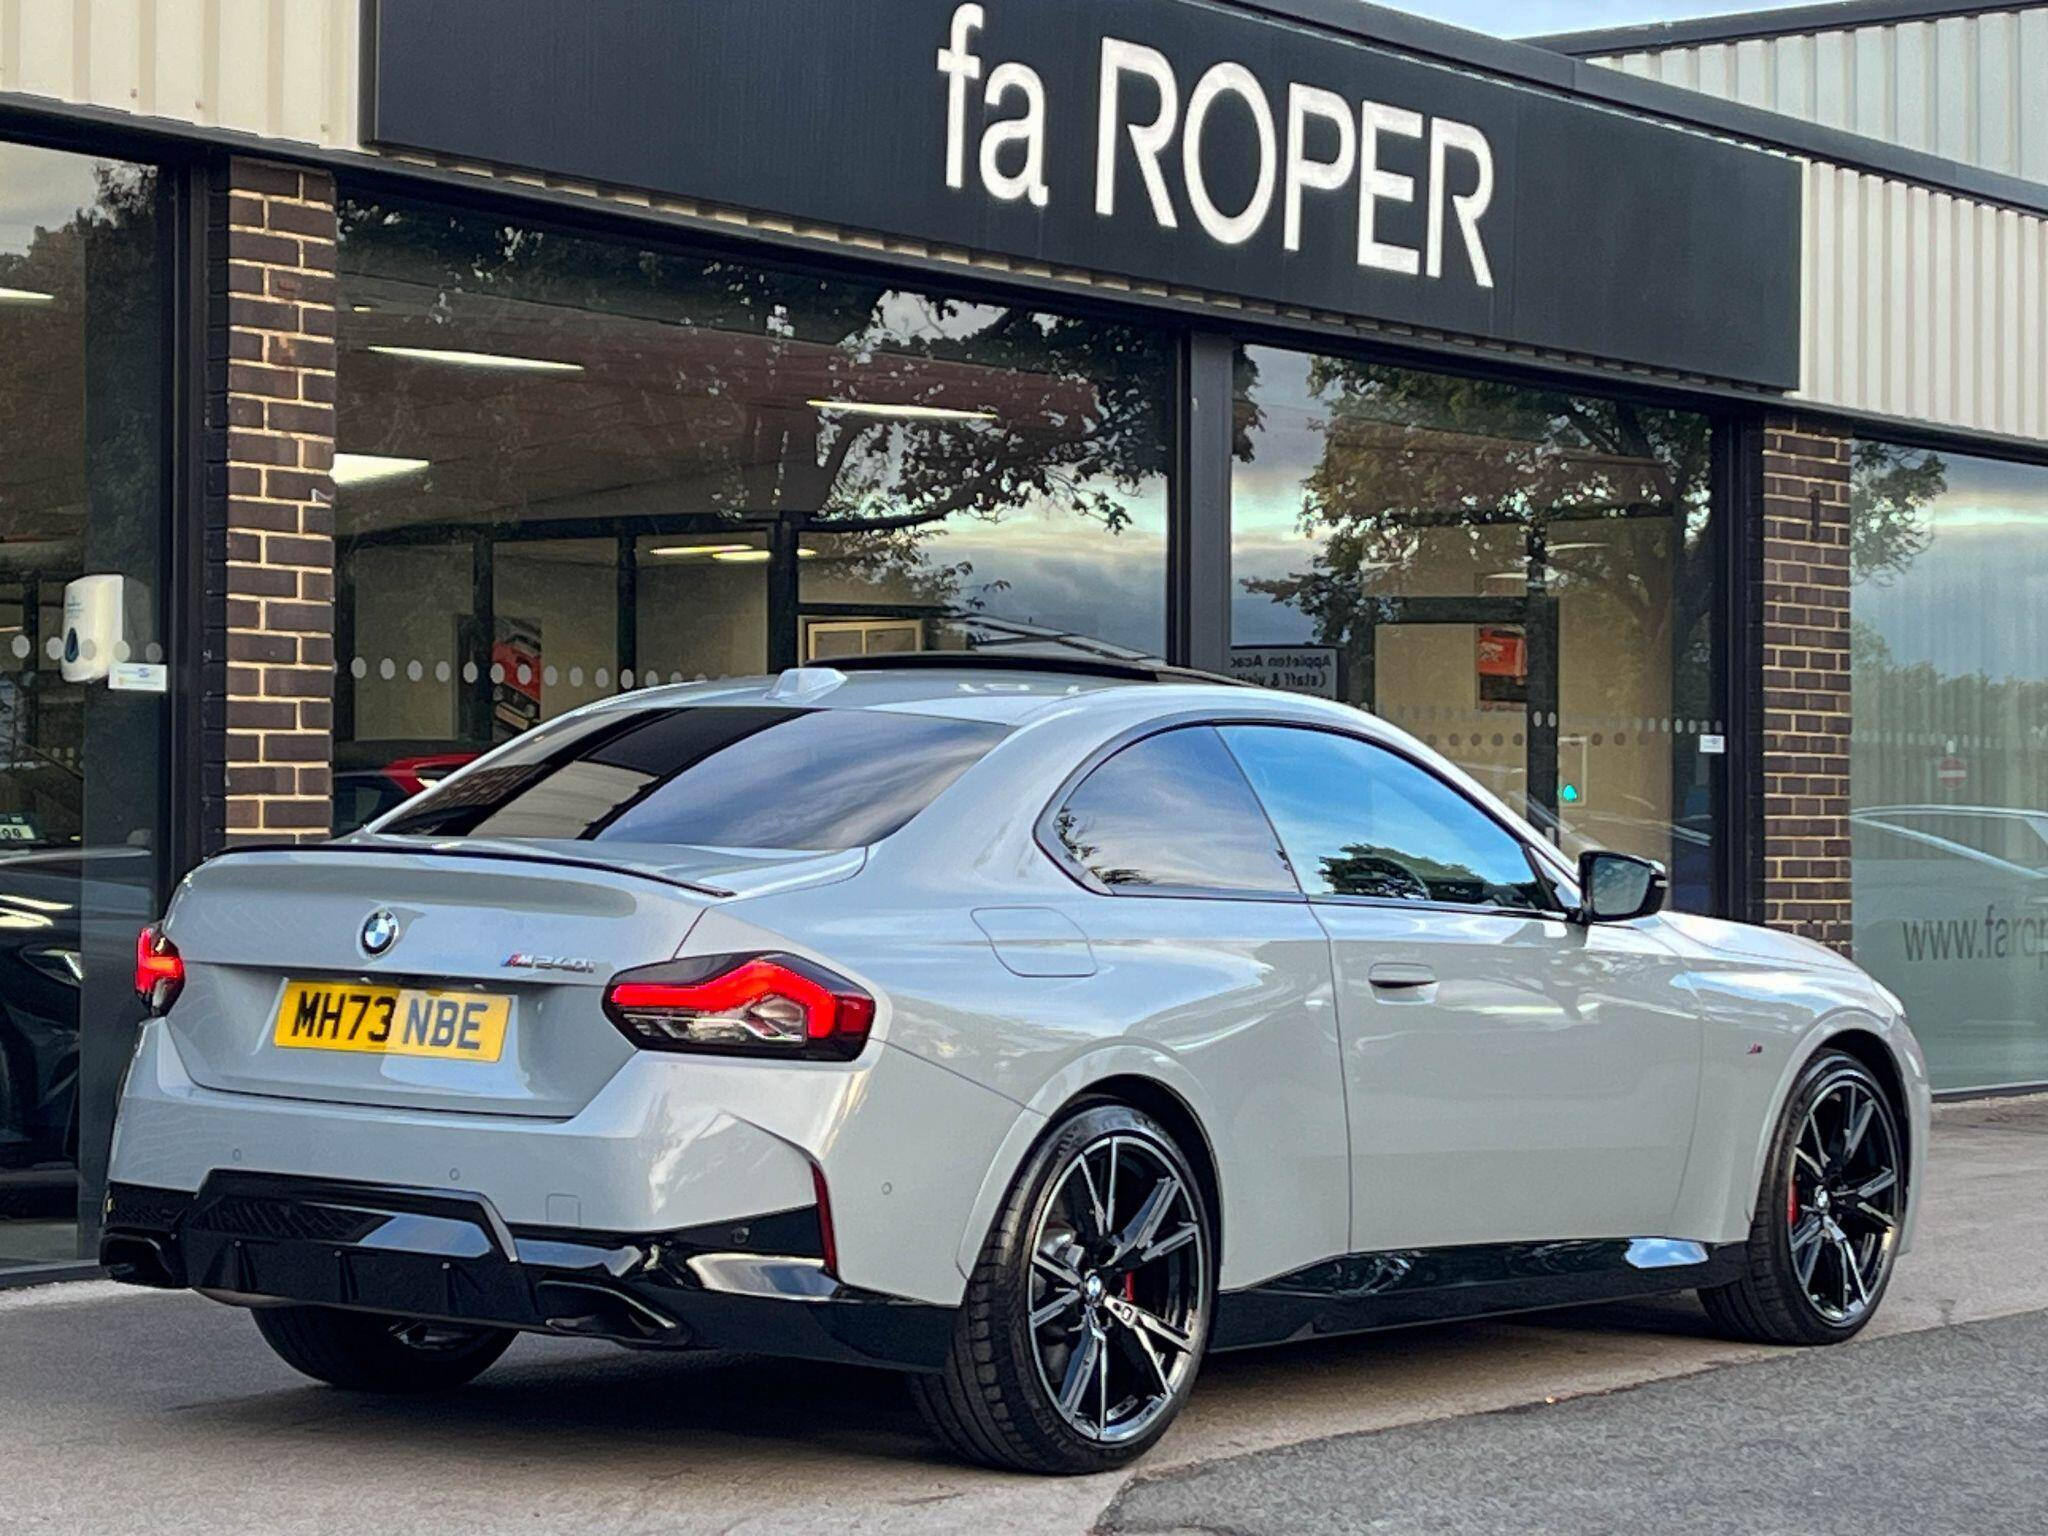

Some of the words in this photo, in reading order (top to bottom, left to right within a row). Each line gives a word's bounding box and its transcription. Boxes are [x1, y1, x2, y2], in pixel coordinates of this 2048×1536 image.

[937, 3, 1049, 207] fa
[1095, 35, 1495, 289] ROPER
[291, 991, 396, 1042] MH73
[402, 998, 488, 1050] NBE
